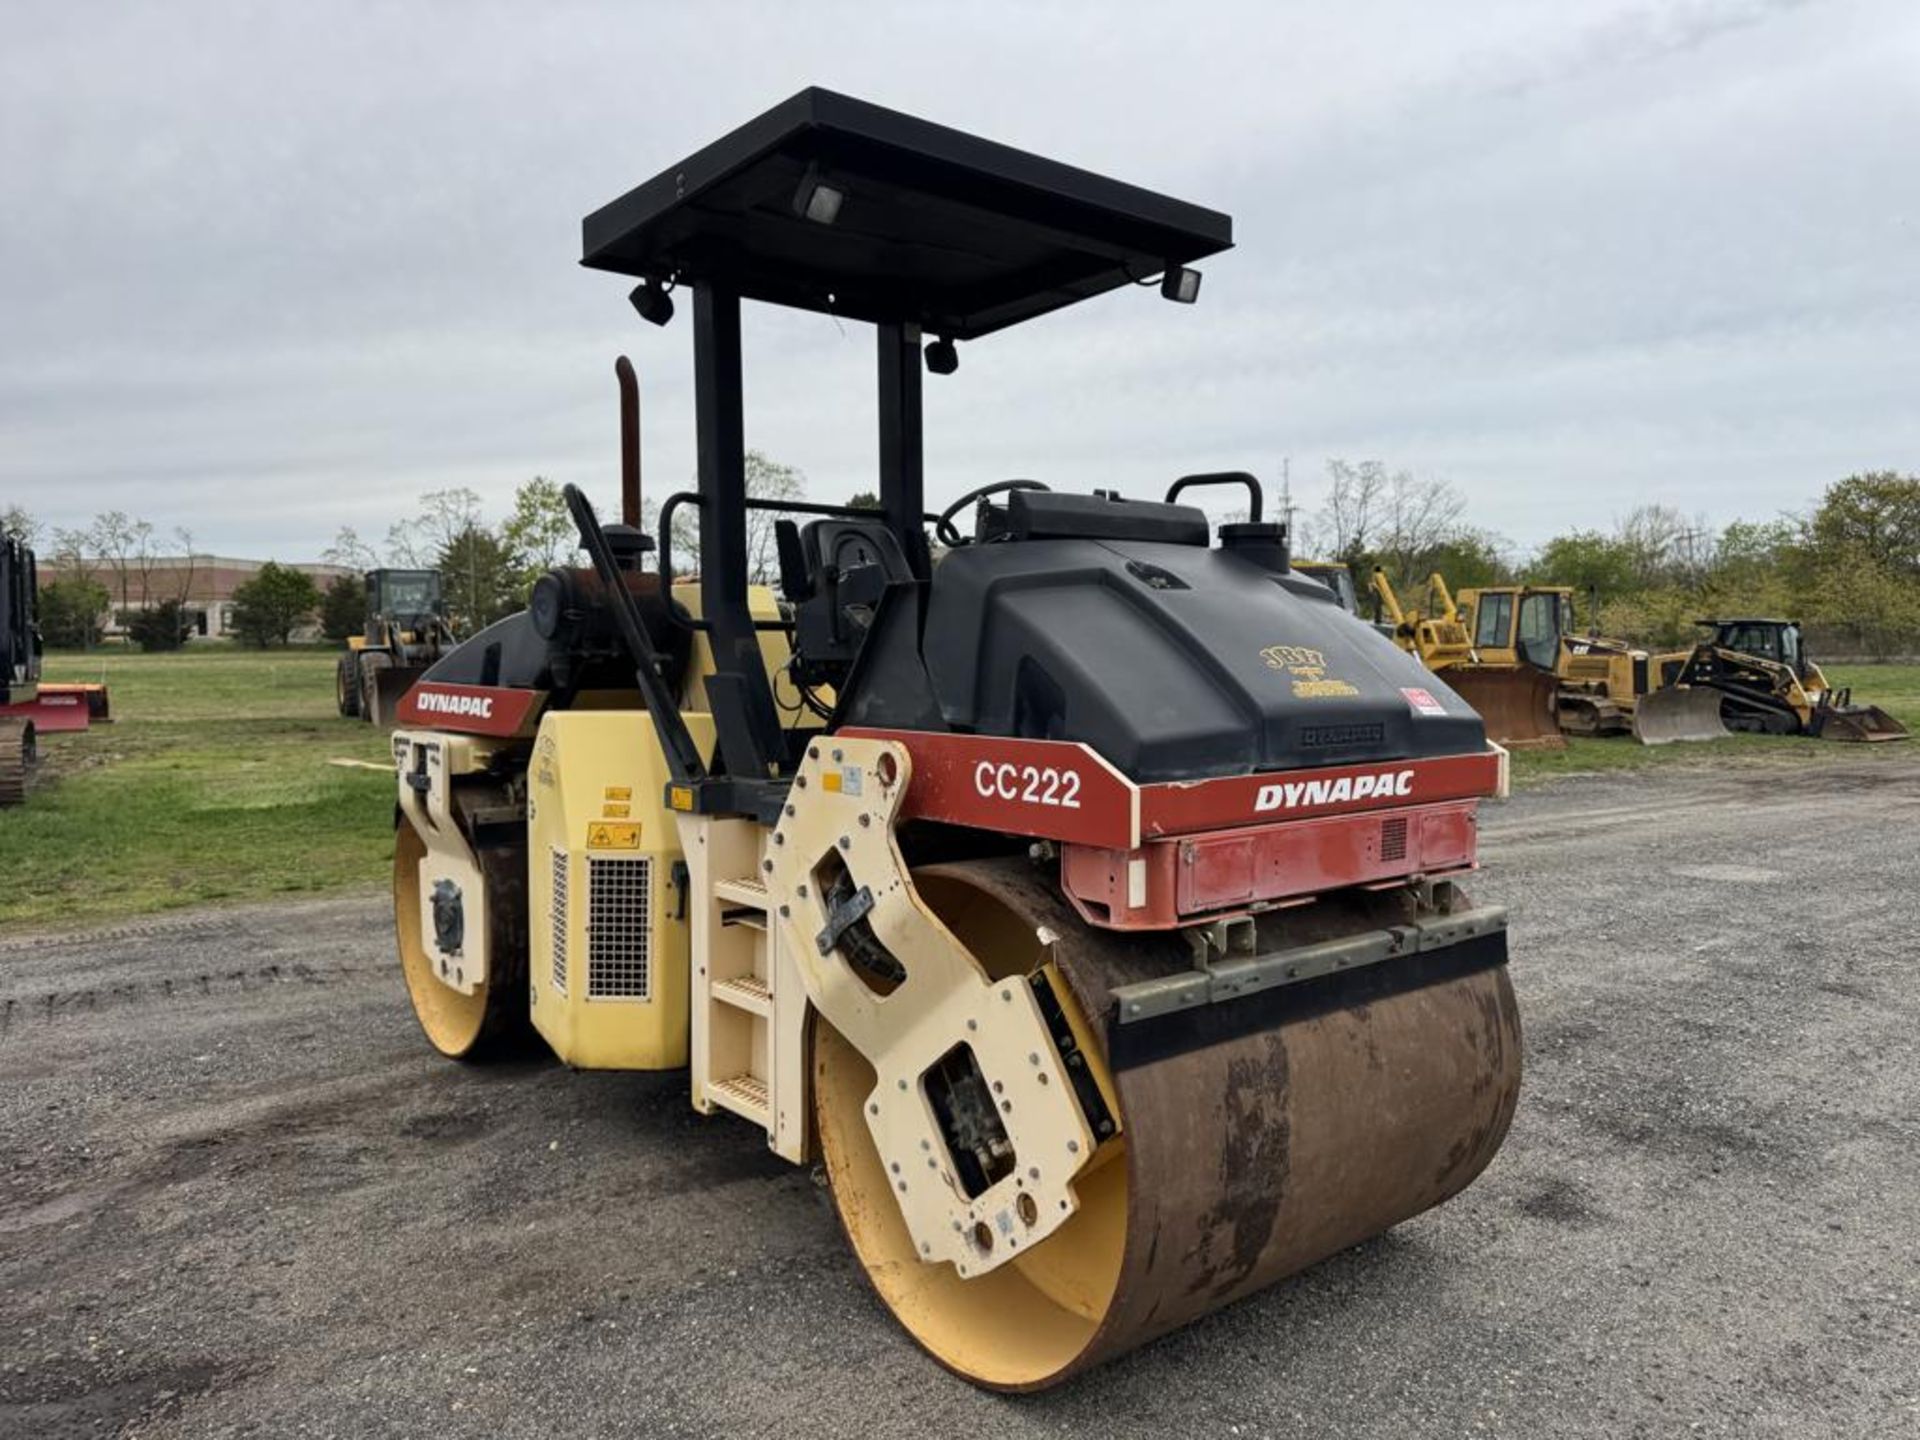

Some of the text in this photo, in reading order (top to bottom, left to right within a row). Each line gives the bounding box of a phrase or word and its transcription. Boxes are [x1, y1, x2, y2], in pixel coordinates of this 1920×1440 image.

[417, 692, 493, 719] DYNAPAC
[975, 761, 1081, 808] CC222
[1254, 770, 1414, 811] DYNAPAC
